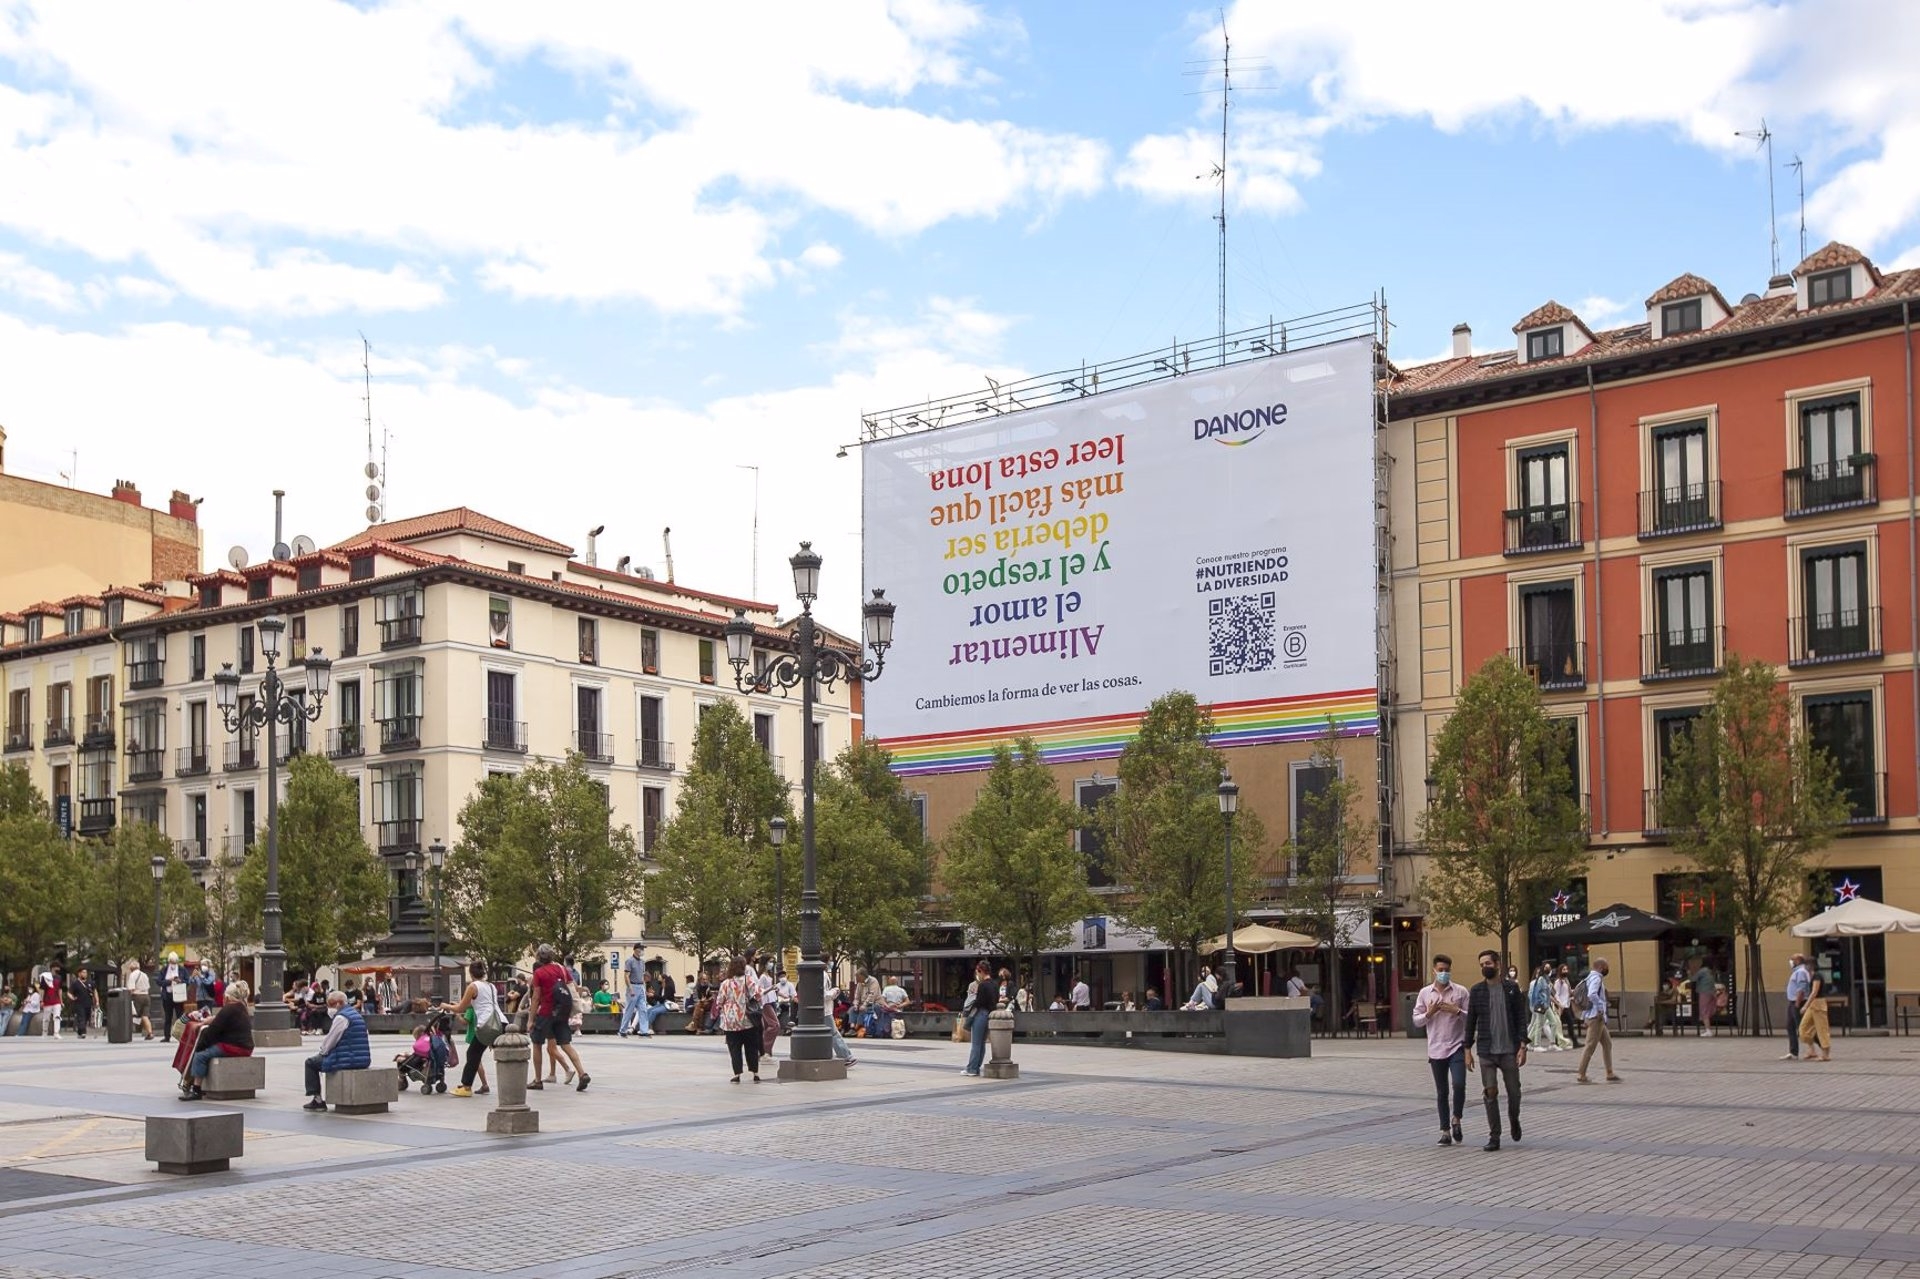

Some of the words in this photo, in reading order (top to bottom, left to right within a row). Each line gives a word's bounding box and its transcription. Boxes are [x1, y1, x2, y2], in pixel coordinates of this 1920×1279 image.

[999, 449, 1059, 478] esta
[1066, 434, 1124, 466] leer
[929, 461, 992, 492] lona
[1061, 472, 1123, 509] más
[931, 492, 981, 526] que
[989, 485, 1052, 525] fácil
[944, 534, 986, 559] ser
[994, 513, 1109, 559] debería
[1060, 554, 1085, 586] el
[1092, 540, 1111, 571] y
[1196, 556, 1222, 564] Conoce
[1225, 552, 1249, 560] nuestro
[1251, 547, 1287, 560] programa
[1196, 556, 1288, 579] #NUTRIENDO
[943, 558, 1051, 595] respeto
[1197, 582, 1212, 592] LA
[1215, 571, 1288, 590] DIVERSIDAD
[970, 596, 1047, 626] amor
[1055, 592, 1081, 623] el
[949, 625, 1104, 665] Alimentar
[916, 695, 985, 709] Cambiemos
[989, 690, 999, 702] la
[1002, 688, 1039, 700] forma
[1042, 683, 1056, 696] de
[1060, 683, 1079, 693] ver
[1083, 679, 1100, 691] las
[1103, 676, 1142, 688] cosas.
